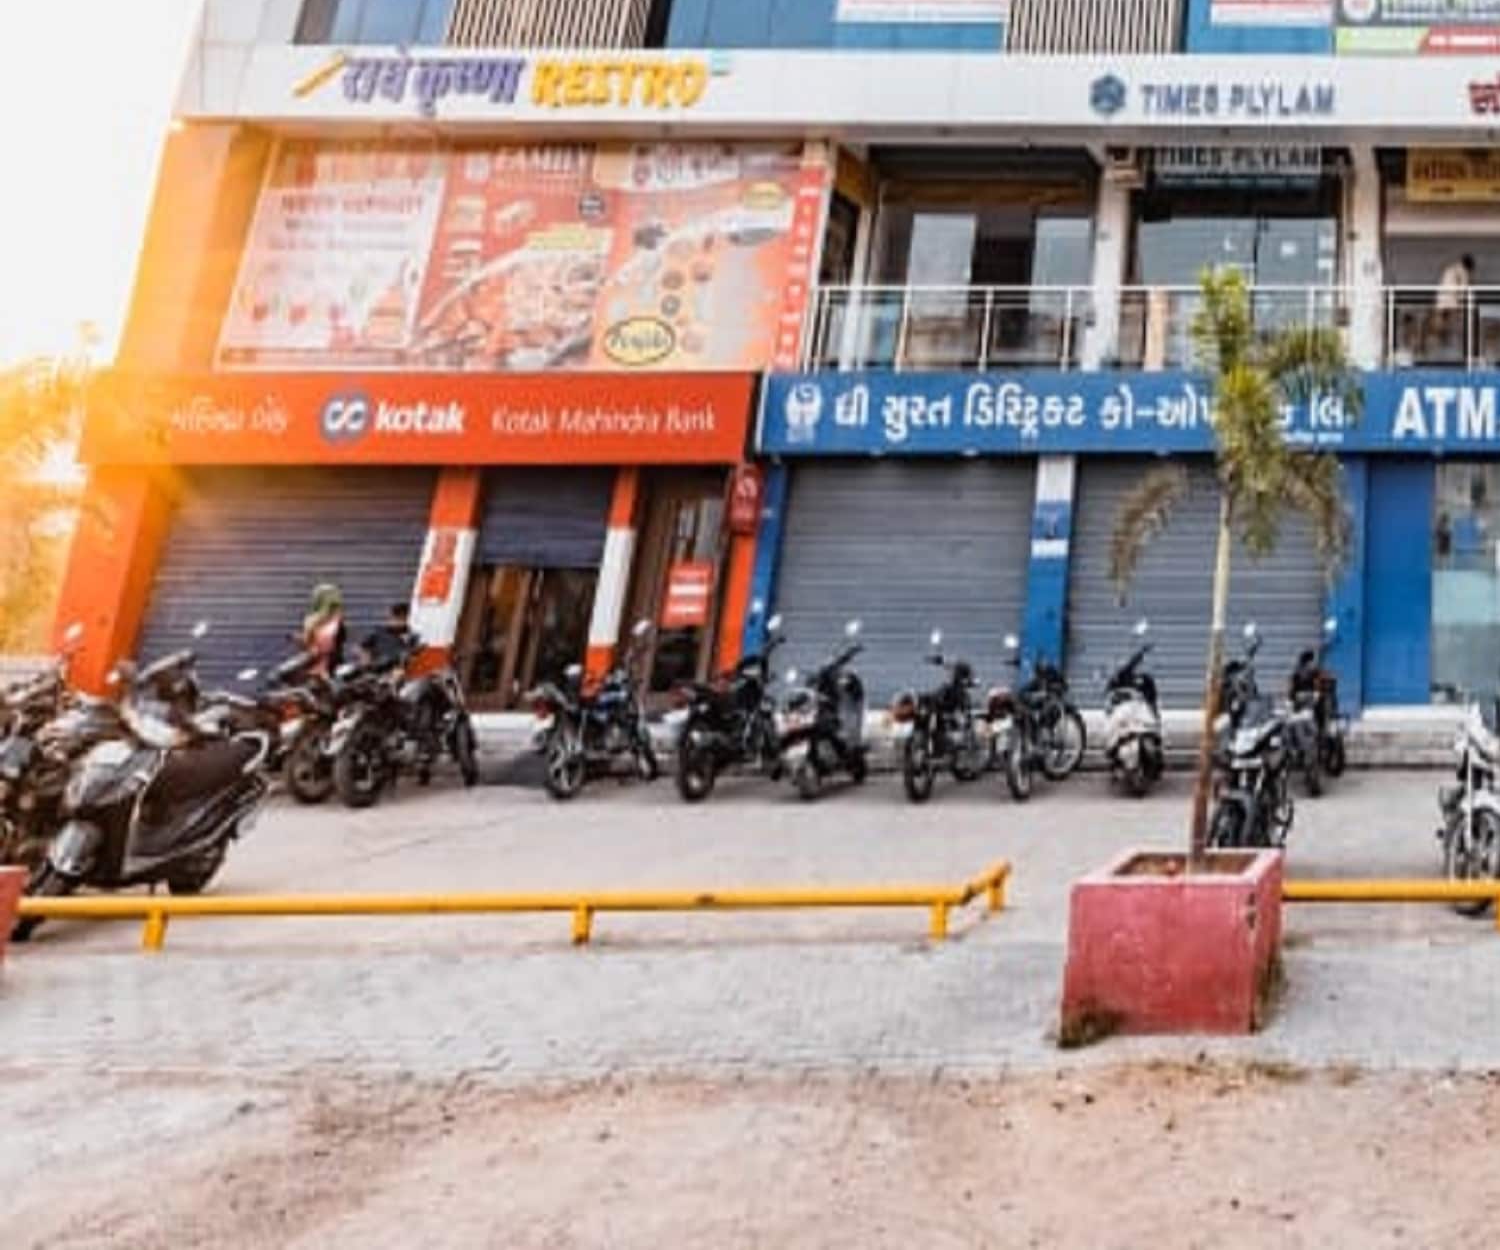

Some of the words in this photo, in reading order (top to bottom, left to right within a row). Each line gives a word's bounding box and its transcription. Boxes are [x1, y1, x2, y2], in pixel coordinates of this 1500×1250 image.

[531, 57, 707, 111] RESTRO
[1142, 84, 1219, 115] TIMES
[1230, 81, 1335, 116] PLYLAM
[375, 399, 465, 434] kotak
[492, 405, 551, 433] Kotak
[561, 403, 660, 433] Mahindra
[666, 403, 716, 432] Bank
[882, 395, 953, 442] સુરત
[1392, 386, 1497, 440] ATM
